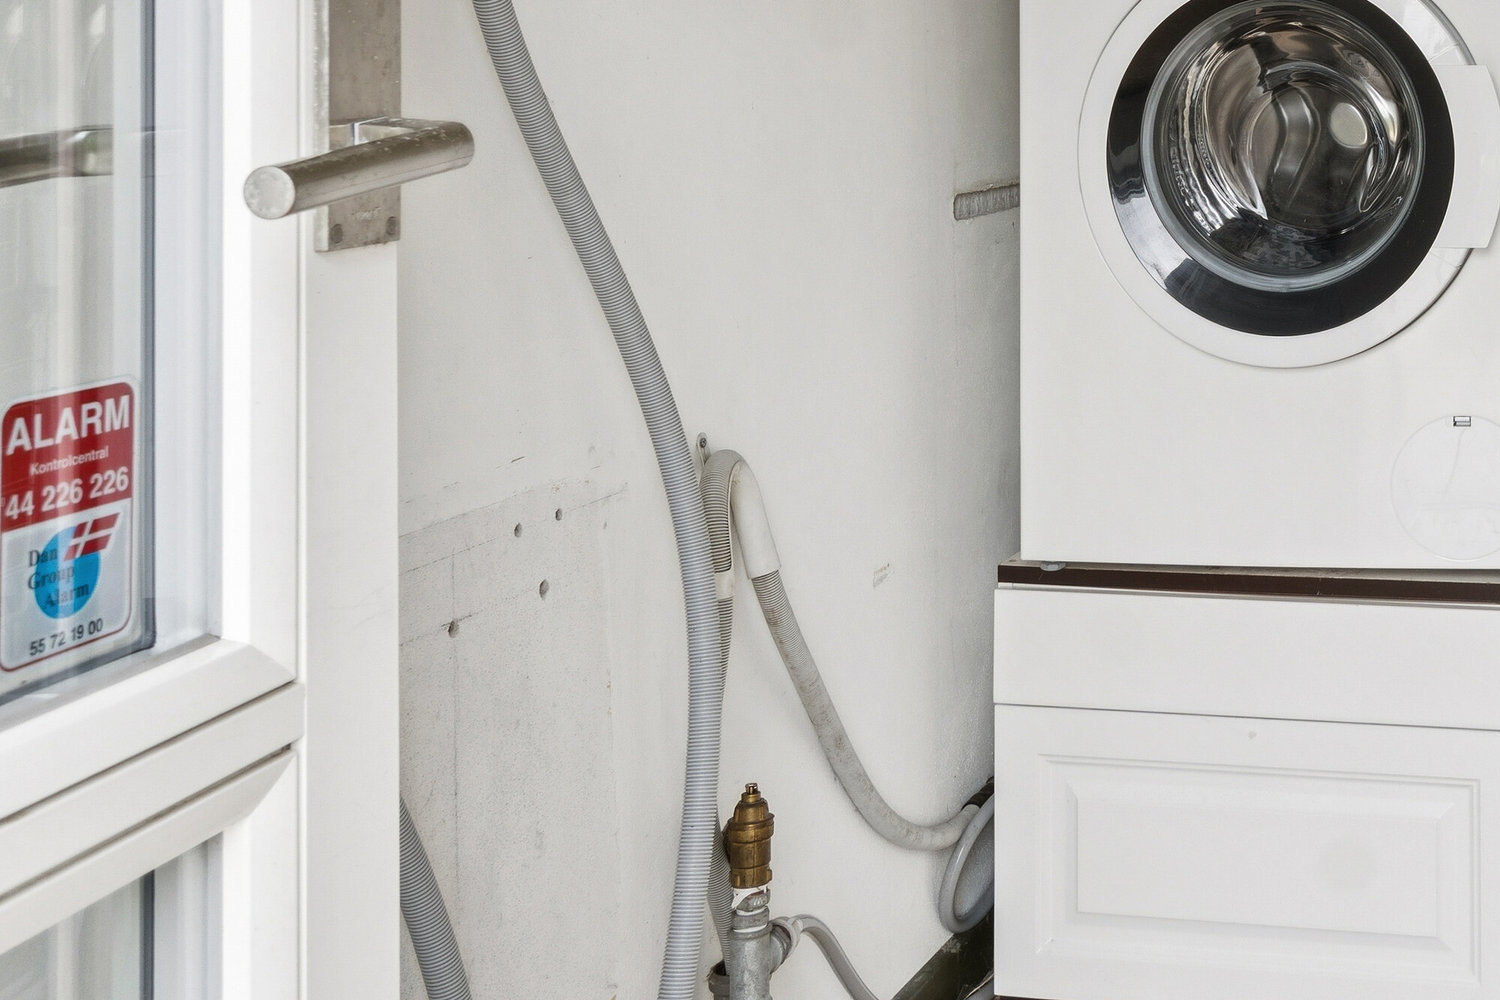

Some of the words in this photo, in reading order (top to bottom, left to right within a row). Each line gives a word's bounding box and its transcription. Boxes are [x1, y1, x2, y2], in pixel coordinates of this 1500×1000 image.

[6, 395, 130, 456] ALARM
[30, 445, 109, 476] Kontrolcentral
[5, 491, 34, 519] 44
[42, 478, 83, 512] 226
[89, 466, 129, 499] 226
[28, 548, 58, 568] Dan
[28, 566, 75, 590] Group
[44, 584, 90, 608] Alarm
[29, 638, 46, 656] 55
[50, 632, 66, 649] 72
[71, 625, 84, 640] 19
[88, 618, 104, 635] 00
